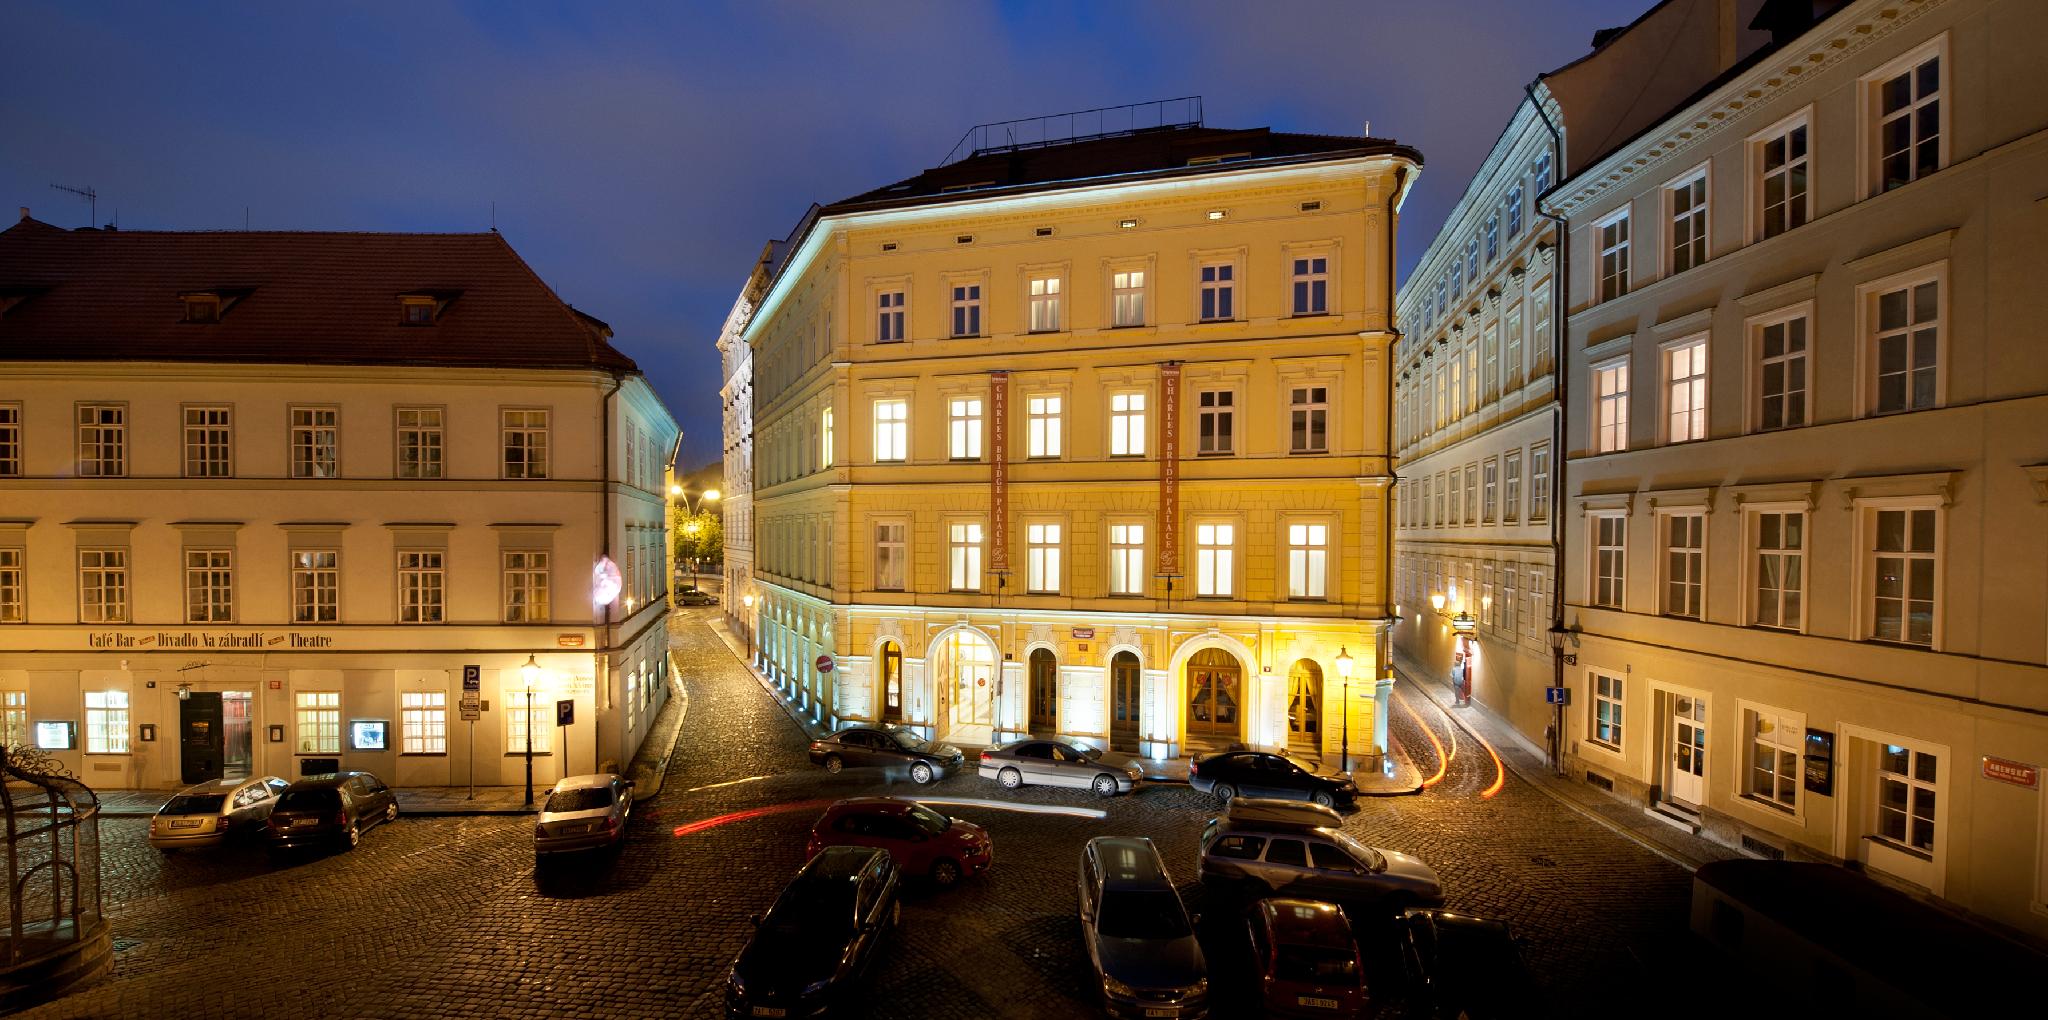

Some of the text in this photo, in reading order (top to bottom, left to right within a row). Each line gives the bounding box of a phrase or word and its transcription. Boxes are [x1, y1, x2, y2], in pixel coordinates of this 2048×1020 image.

[1165, 498, 1173, 548] PALACE
[89, 632, 113, 648] Café
[116, 632, 136, 648] Bar
[157, 632, 198, 648] Divadlo
[202, 632, 216, 648] Na
[218, 632, 265, 648] zábradlí
[288, 632, 332, 648] Theatre
[466, 668, 477, 682] P
[560, 703, 571, 718] P
